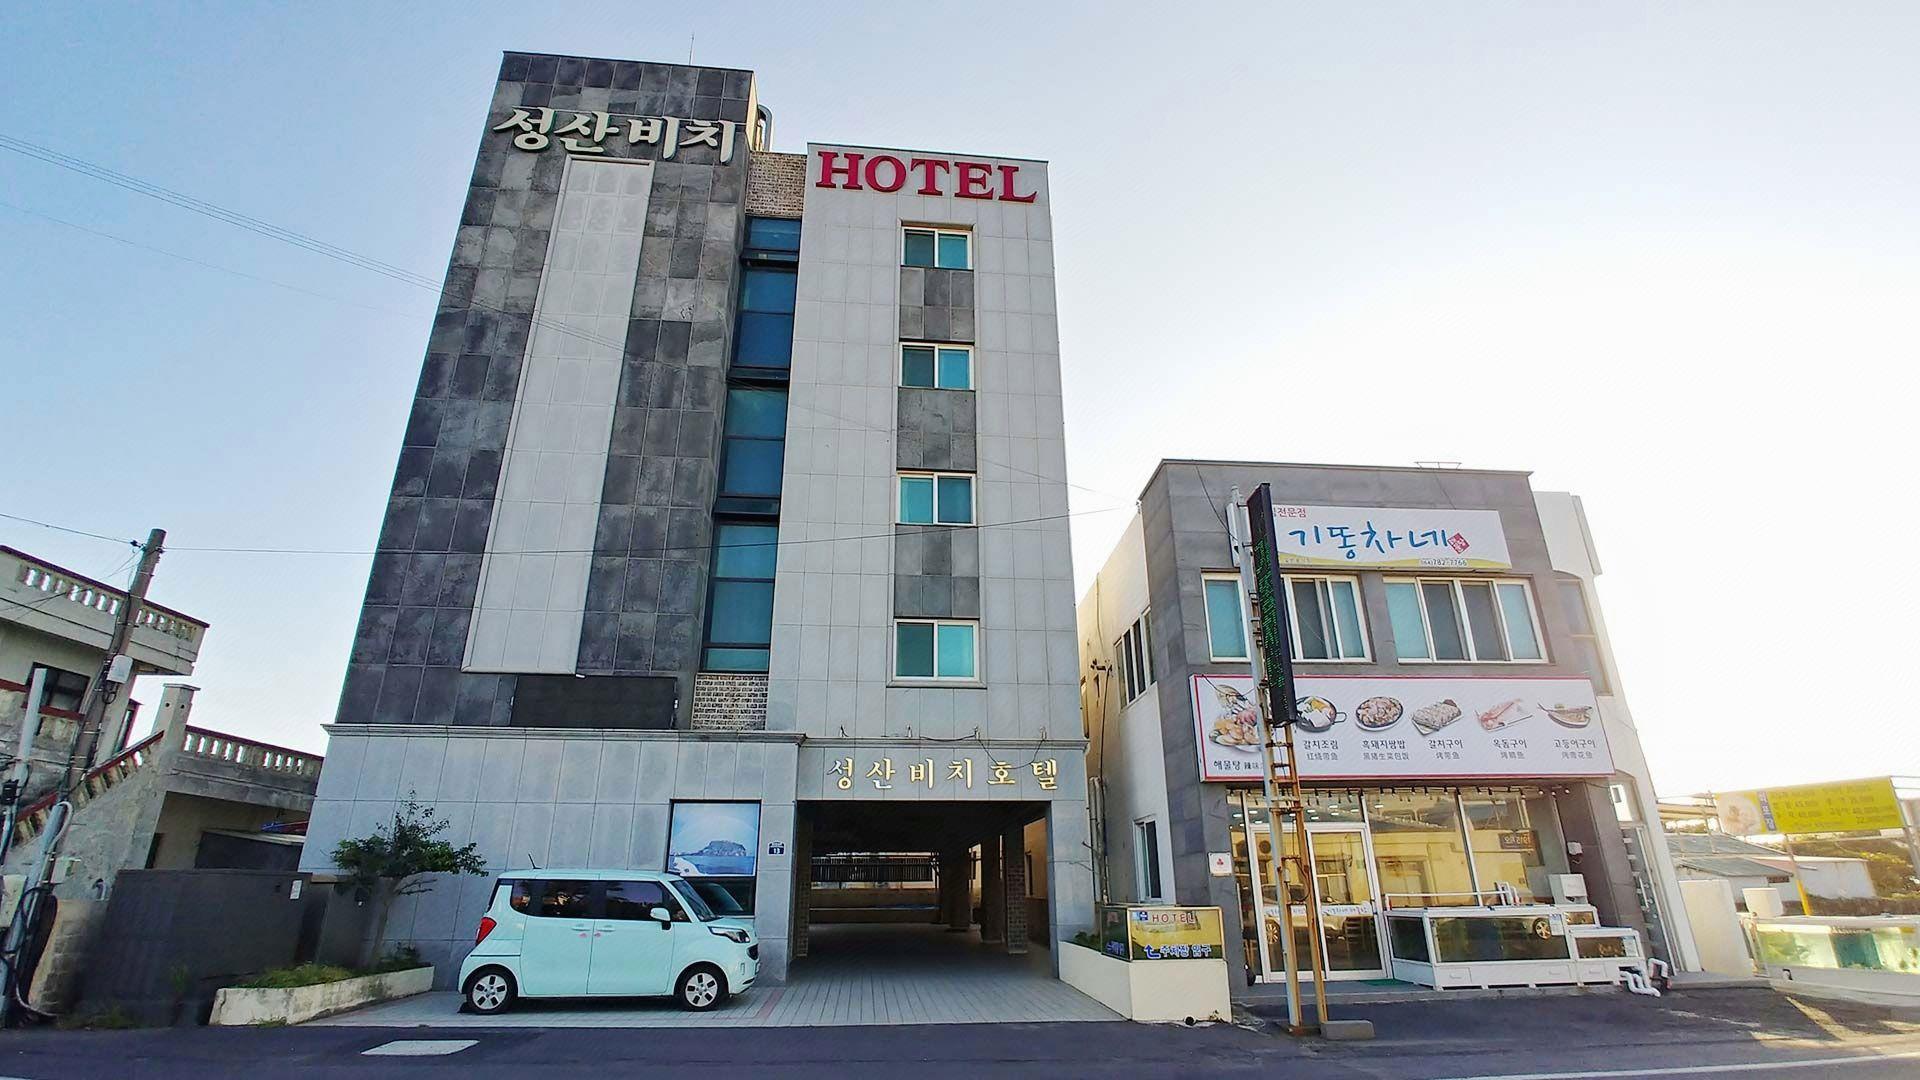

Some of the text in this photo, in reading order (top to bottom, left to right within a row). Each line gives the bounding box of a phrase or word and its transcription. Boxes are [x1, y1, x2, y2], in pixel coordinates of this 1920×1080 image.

[493, 106, 738, 164] 성산비치
[815, 151, 1037, 203] HOTEL
[1273, 507, 1306, 518] 전문점
[1288, 520, 1448, 559] 기똥차네
[1303, 739, 1338, 749] 갈치조림
[1362, 740, 1406, 750] 흑돼지쌈밥
[1428, 739, 1463, 749] 갈치구이
[1493, 739, 1527, 749] 옥돔구이
[1554, 739, 1596, 748] 고등어구이
[1213, 760, 1240, 770] 해물탕
[1152, 913, 1195, 923] HOTEL
